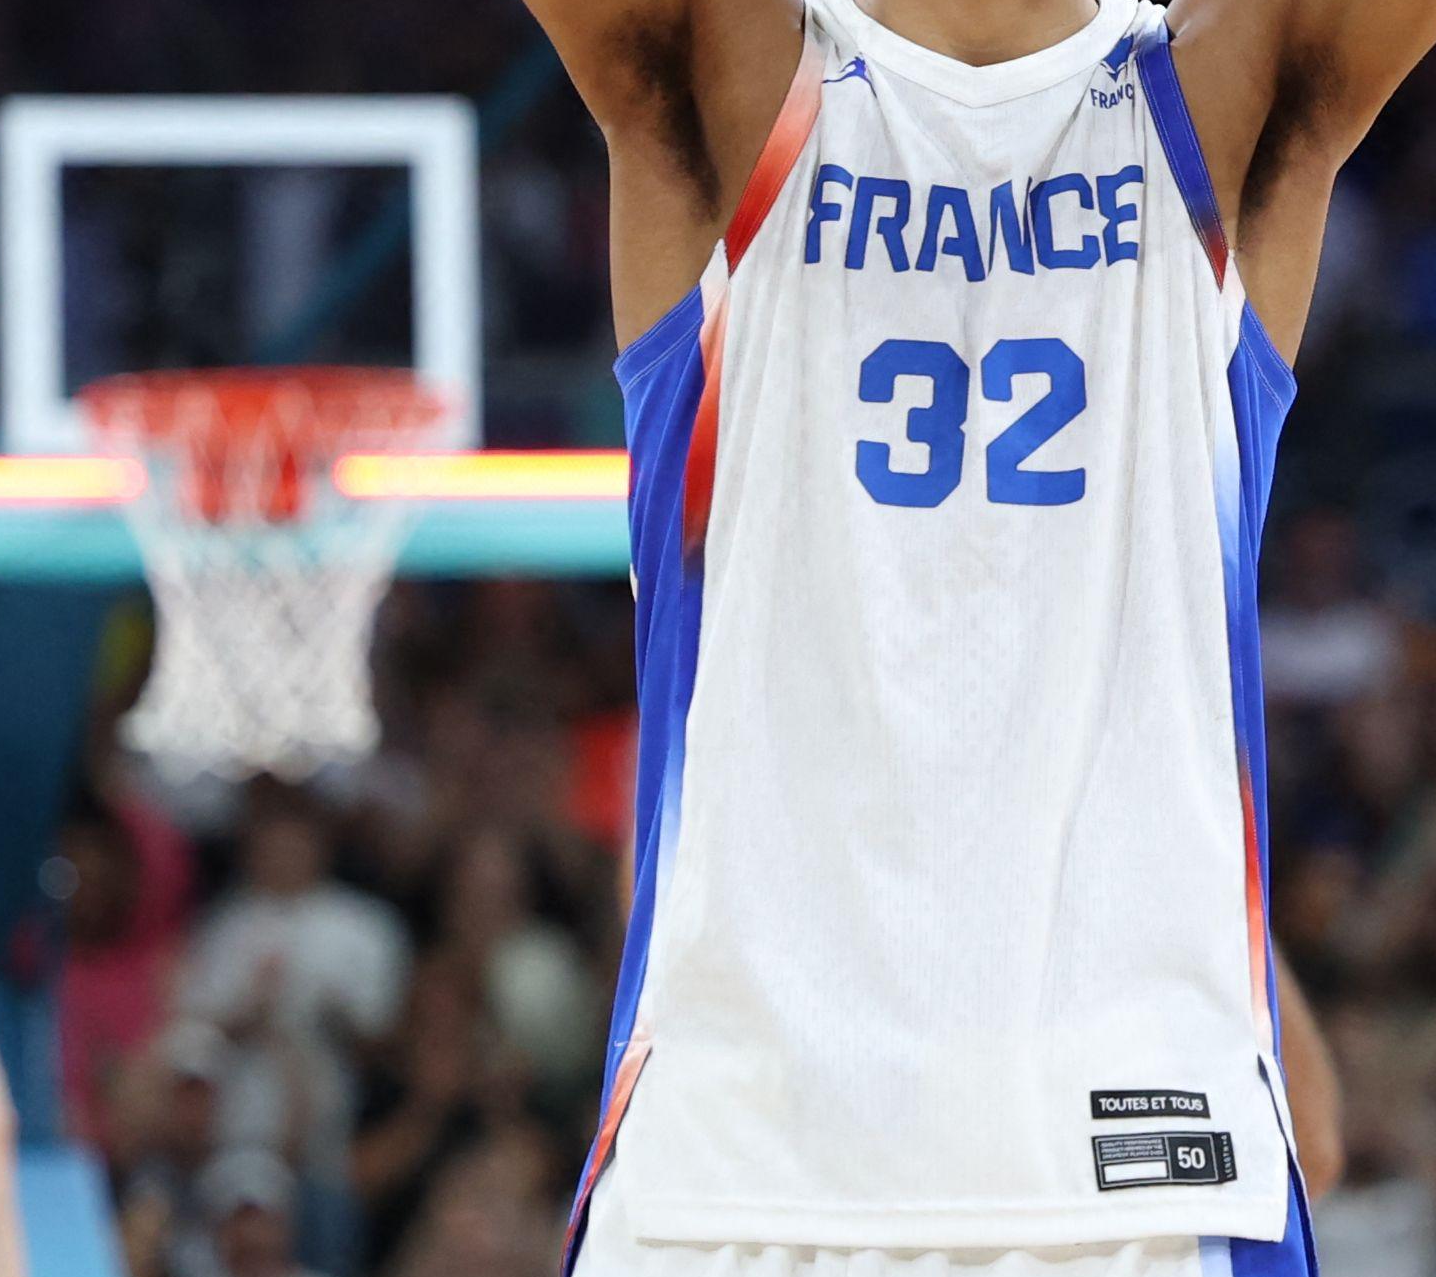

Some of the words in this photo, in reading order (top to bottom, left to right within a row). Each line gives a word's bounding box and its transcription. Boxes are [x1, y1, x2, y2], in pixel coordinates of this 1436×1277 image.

[1090, 83, 1134, 109] FRANC
[804, 164, 1144, 282] FRANCE
[856, 337, 1087, 507] 32
[1099, 1097, 1149, 1111] TOUTES
[1151, 1096, 1167, 1110] ET
[1169, 1096, 1204, 1112] TOUS
[1176, 1146, 1206, 1169] 50
